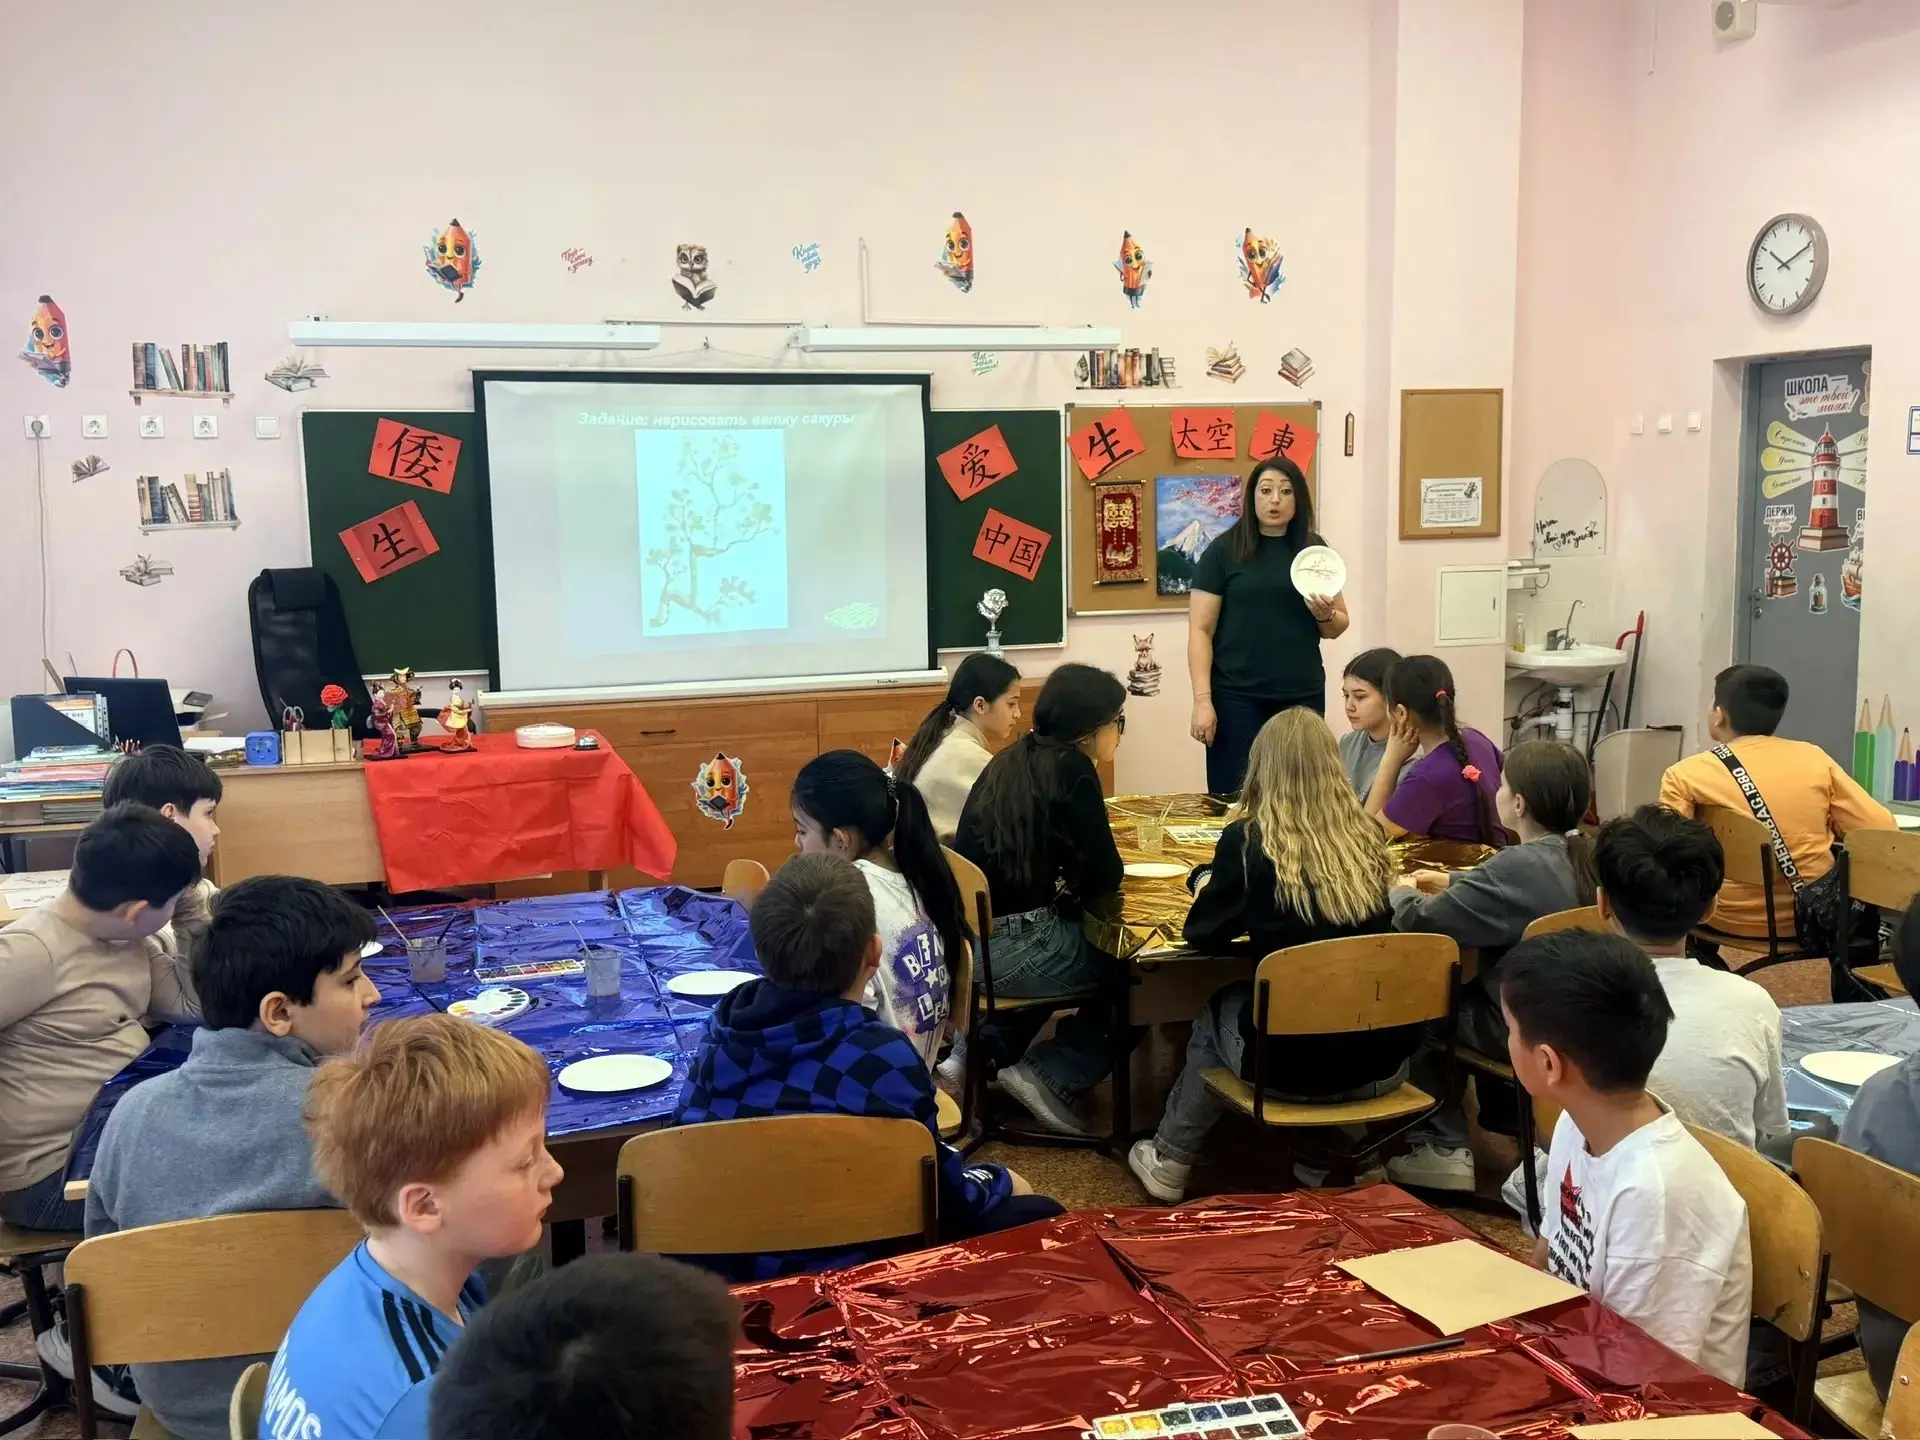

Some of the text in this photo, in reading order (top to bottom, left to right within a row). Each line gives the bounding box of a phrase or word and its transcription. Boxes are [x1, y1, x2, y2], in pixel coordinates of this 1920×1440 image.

[1786, 377, 1828, 396] ШКОЛА
[1799, 385, 1849, 405] это твой
[1817, 391, 1858, 411] маяк!
[653, 414, 746, 428] нарисовать
[752, 414, 798, 428] ветку
[802, 413, 855, 428] сакуры
[1176, 417, 1234, 451] 太空
[387, 427, 444, 487] 倭
[960, 443, 1001, 488] 爱
[1088, 421, 1134, 476] 生
[1766, 506, 1793, 517] ДЕРЖИ
[372, 522, 420, 569] 生
[984, 523, 1042, 573] 中国
